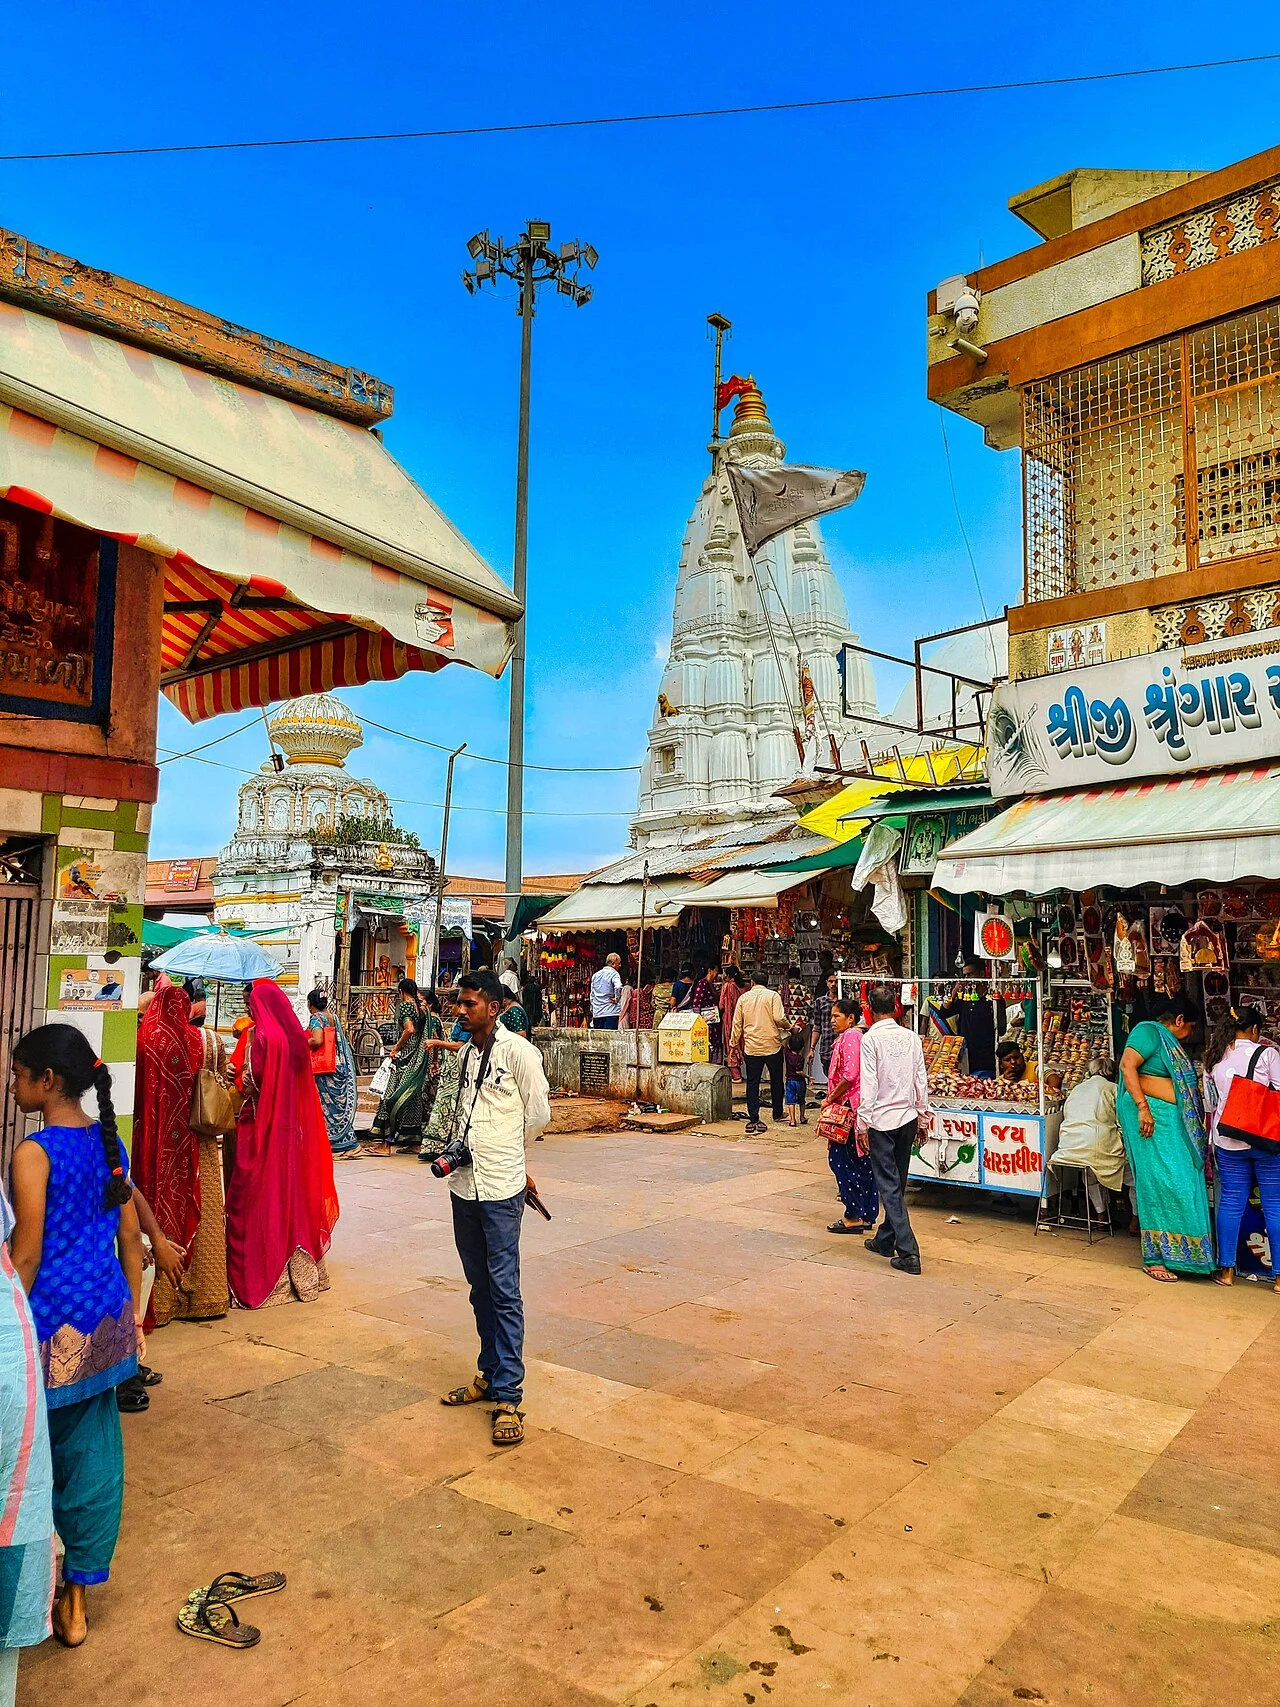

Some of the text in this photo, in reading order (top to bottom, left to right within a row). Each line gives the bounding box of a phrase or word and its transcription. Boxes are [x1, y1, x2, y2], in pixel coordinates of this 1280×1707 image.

[1046, 685, 1134, 758] શ્રીજી
[956, 811, 967, 825] શ્રી
[942, 1118, 977, 1138] કૃષ્ણ
[990, 1125, 1026, 1143] જય
